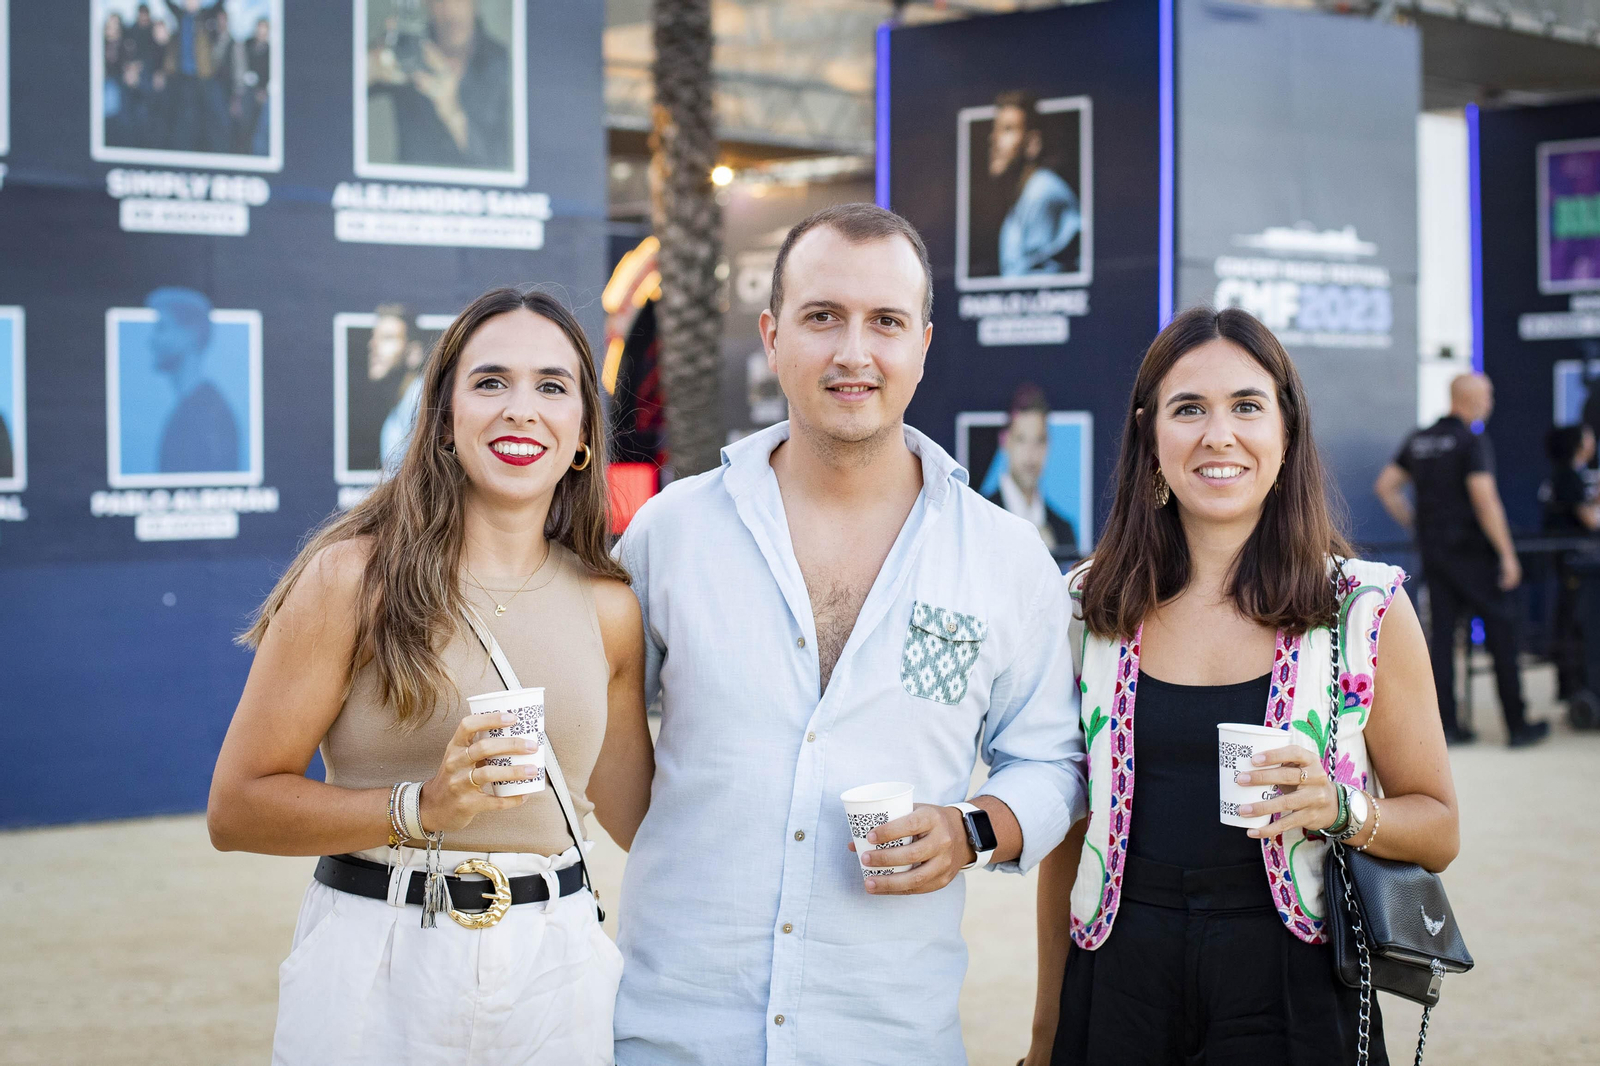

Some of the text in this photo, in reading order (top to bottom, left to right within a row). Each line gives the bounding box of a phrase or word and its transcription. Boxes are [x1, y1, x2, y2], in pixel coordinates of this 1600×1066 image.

[107, 169, 270, 206] SIMPLY RED
[332, 182, 552, 221] ALEJANDRO SANZ
